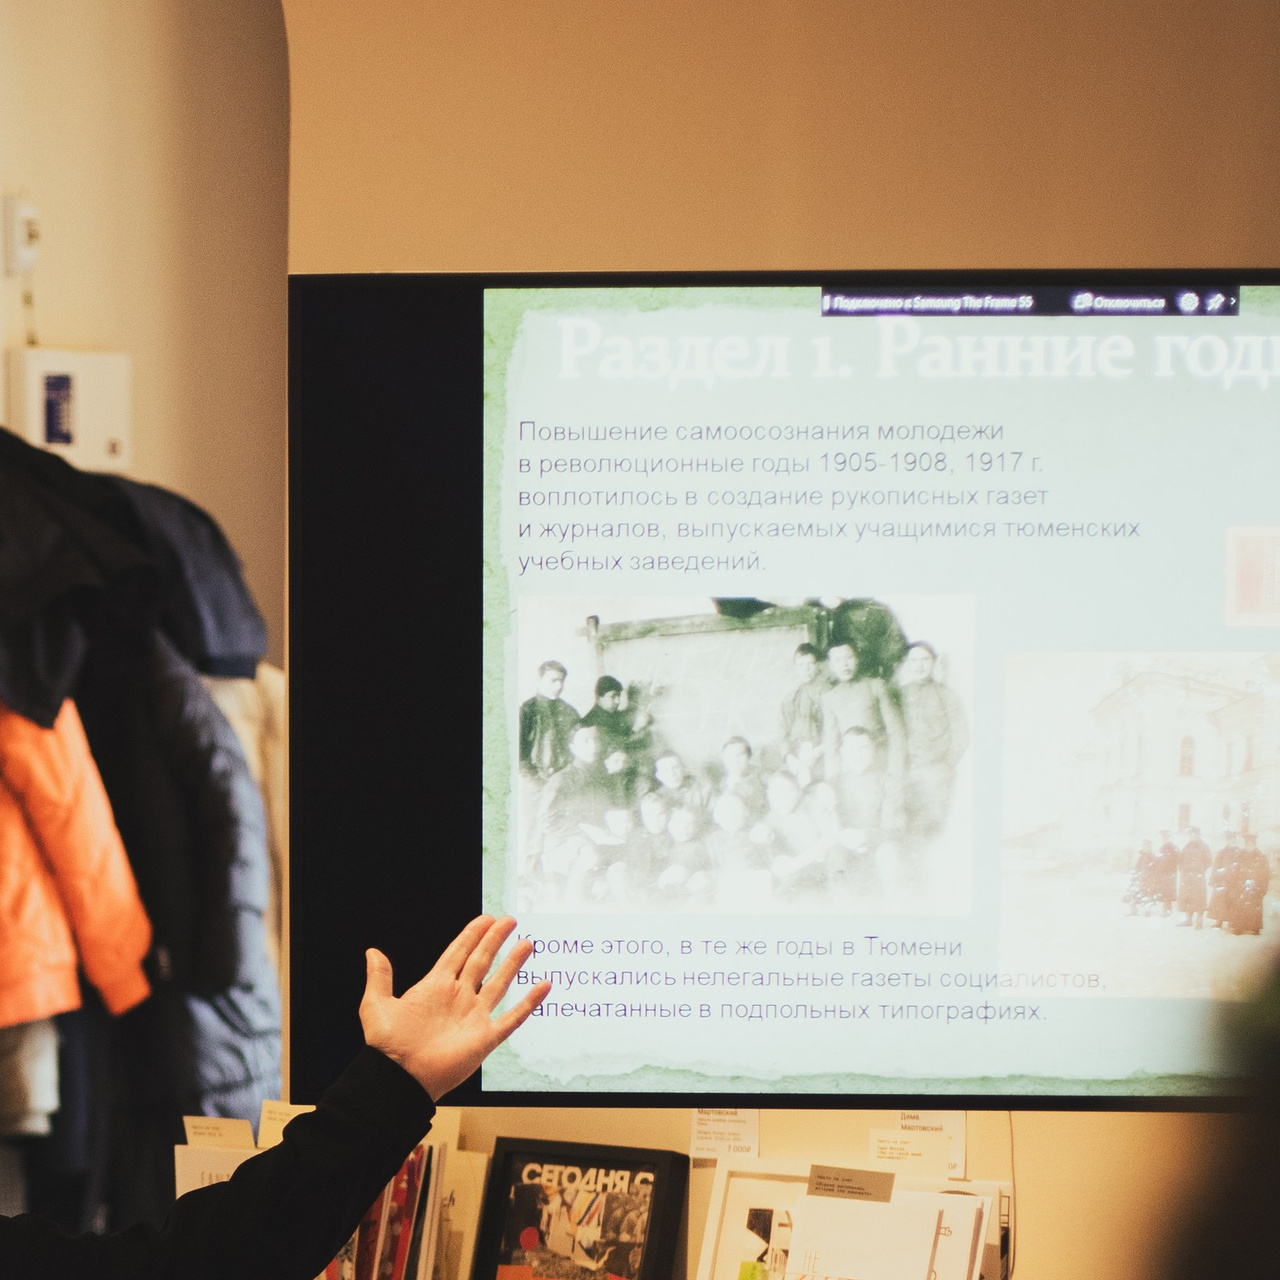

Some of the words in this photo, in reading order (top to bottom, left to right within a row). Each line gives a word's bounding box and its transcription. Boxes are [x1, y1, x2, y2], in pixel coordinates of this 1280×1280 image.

[913, 295, 961, 313] Samsung
[962, 295, 982, 309] The
[984, 295, 1017, 309] Frame
[1018, 295, 1034, 309] 55
[1094, 296, 1166, 310] Отключиться
[557, 317, 792, 392] Раздел
[876, 315, 1136, 379] Ранние
[1153, 332, 1280, 391] год
[518, 420, 669, 442] Повышение
[675, 424, 870, 441] самоосознания
[877, 424, 1004, 443] молодежи
[518, 457, 532, 474] в
[539, 457, 745, 479] революционные
[752, 457, 810, 476] годы
[820, 451, 954, 476] 1905-1908,
[966, 451, 1024, 473] 1917
[1031, 456, 1044, 473] г.
[518, 490, 679, 507] воплотилось
[684, 490, 698, 506] в
[706, 490, 824, 509] создание
[831, 489, 979, 511] рукописных
[986, 489, 1050, 506] газет
[518, 522, 532, 539] и
[539, 522, 667, 544] журналов,
[676, 522, 848, 544] выпускаемых
[854, 521, 997, 543] учащимися
[1003, 521, 1141, 539] тюменских
[518, 550, 624, 577] учебных
[629, 550, 767, 575] заведений.
[600, 938, 671, 958] этого,
[679, 939, 694, 956] в
[700, 939, 728, 956] те
[734, 939, 768, 956] же
[775, 939, 833, 959] годы
[842, 940, 856, 957] в
[862, 935, 963, 957] Тюмени
[682, 970, 845, 988] нелегальные
[851, 971, 932, 988] газеты
[939, 972, 1107, 993] социалистов,
[531, 1002, 692, 1018] апечатанные
[698, 1003, 712, 1018] в
[720, 1003, 870, 1021] подпольных
[877, 1000, 1048, 1025] типографиях.
[521, 1162, 631, 1194] СЕГОДНЯ
[803, 1250, 820, 1274] НЕ
